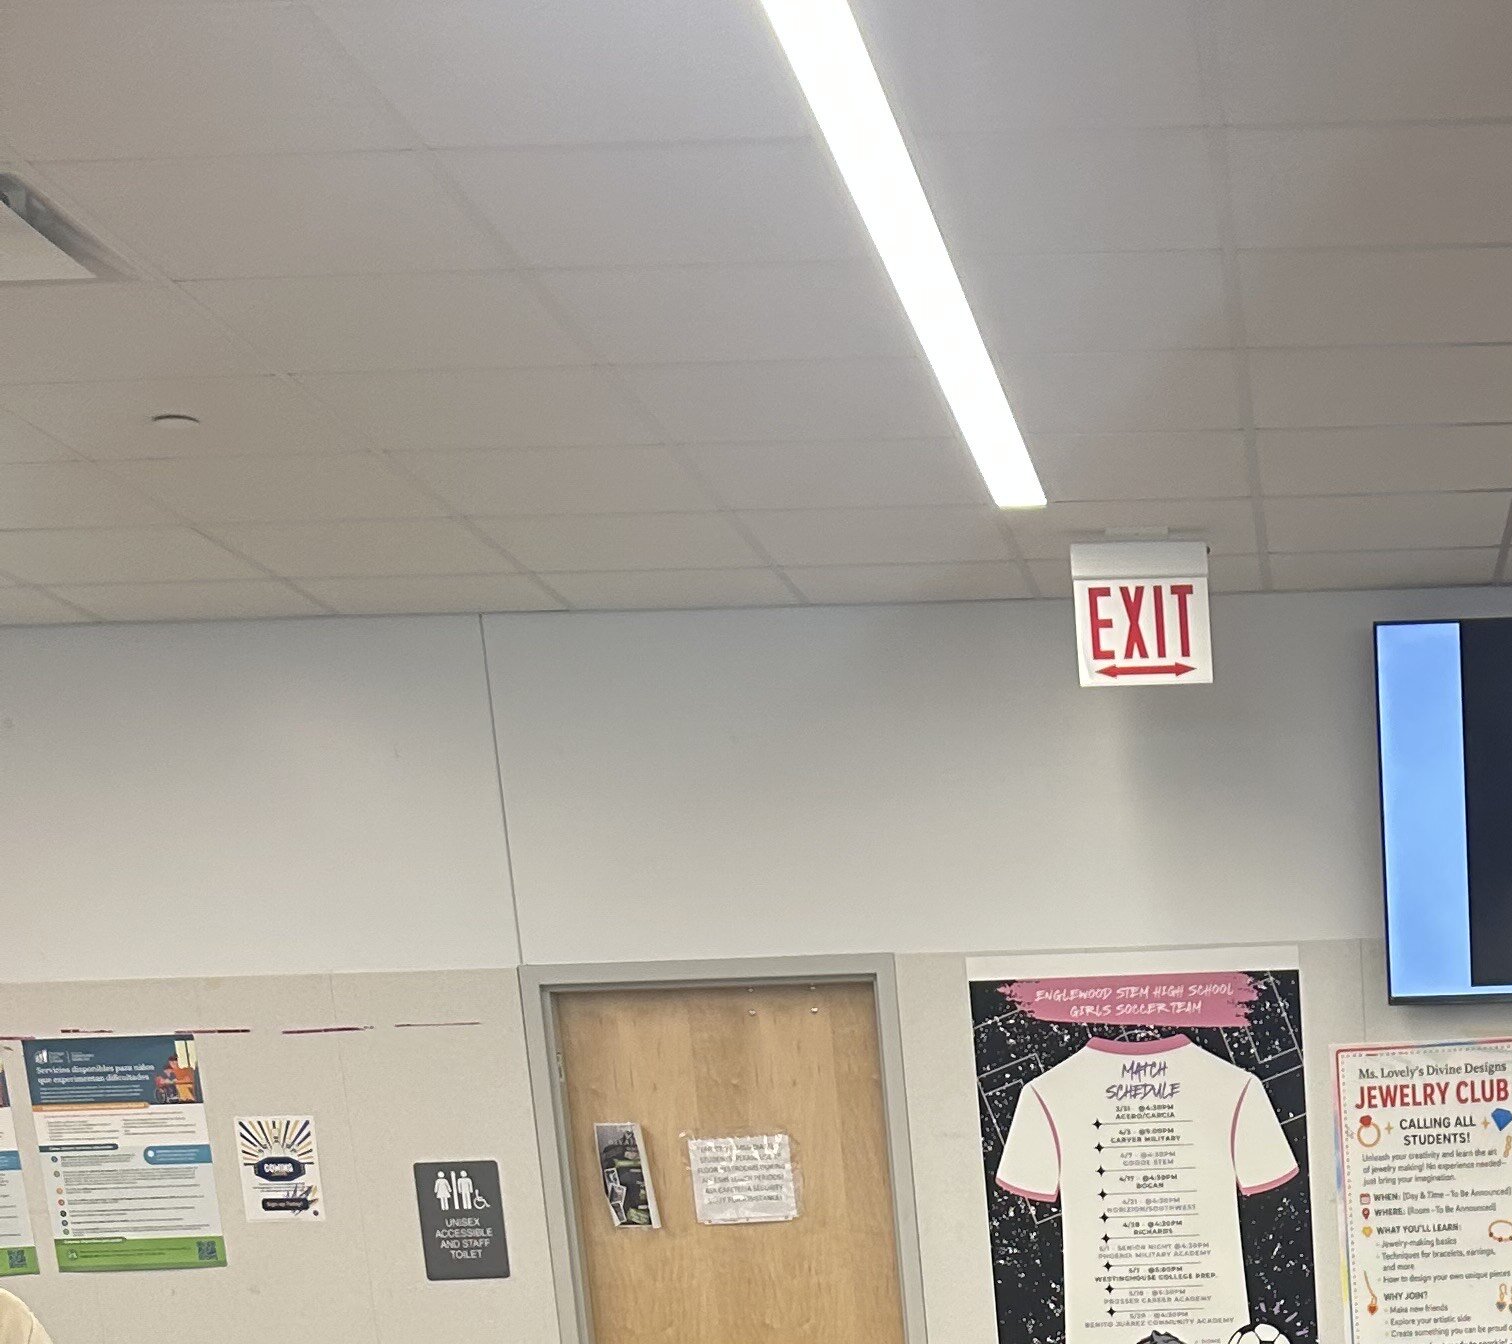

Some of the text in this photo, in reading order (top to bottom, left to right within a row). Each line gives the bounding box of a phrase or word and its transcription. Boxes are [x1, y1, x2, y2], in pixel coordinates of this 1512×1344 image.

[1088, 583, 1195, 661] EXIT
[1034, 982, 1233, 1001] ENGLEWOOD STEM HIGH SCHOOL
[1070, 1001, 1203, 1017] GIRLS SOCCER TEAM
[1121, 1061, 1167, 1078] MATCH
[1358, 1062, 1507, 1079] Ms. Lovely's Divine Designs
[1105, 1083, 1180, 1100] SCHEDULE
[1355, 1078, 1509, 1109] JEWELRY CLUB
[1400, 1115, 1476, 1130] CALLING ALL
[1404, 1132, 1471, 1146] STUDENTS!
[1392, 1153, 1407, 1161] your
[1442, 1150, 1454, 1158] and
[1456, 1149, 1473, 1157] learn
[1475, 1149, 1486, 1157] the
[1488, 1148, 1497, 1156] art
[1362, 1165, 1371, 1173] of
[1398, 1175, 1412, 1185] your
[445, 1218, 480, 1227] UNISEX
[436, 1228, 493, 1238] ACCESSIBLE
[1377, 1226, 1400, 1235] WHAT
[441, 1238, 490, 1248] AND STAFF
[450, 1250, 482, 1259] TOILET
[1383, 1263, 1396, 1271] and
[1383, 1290, 1428, 1301] WHY JOIN?
